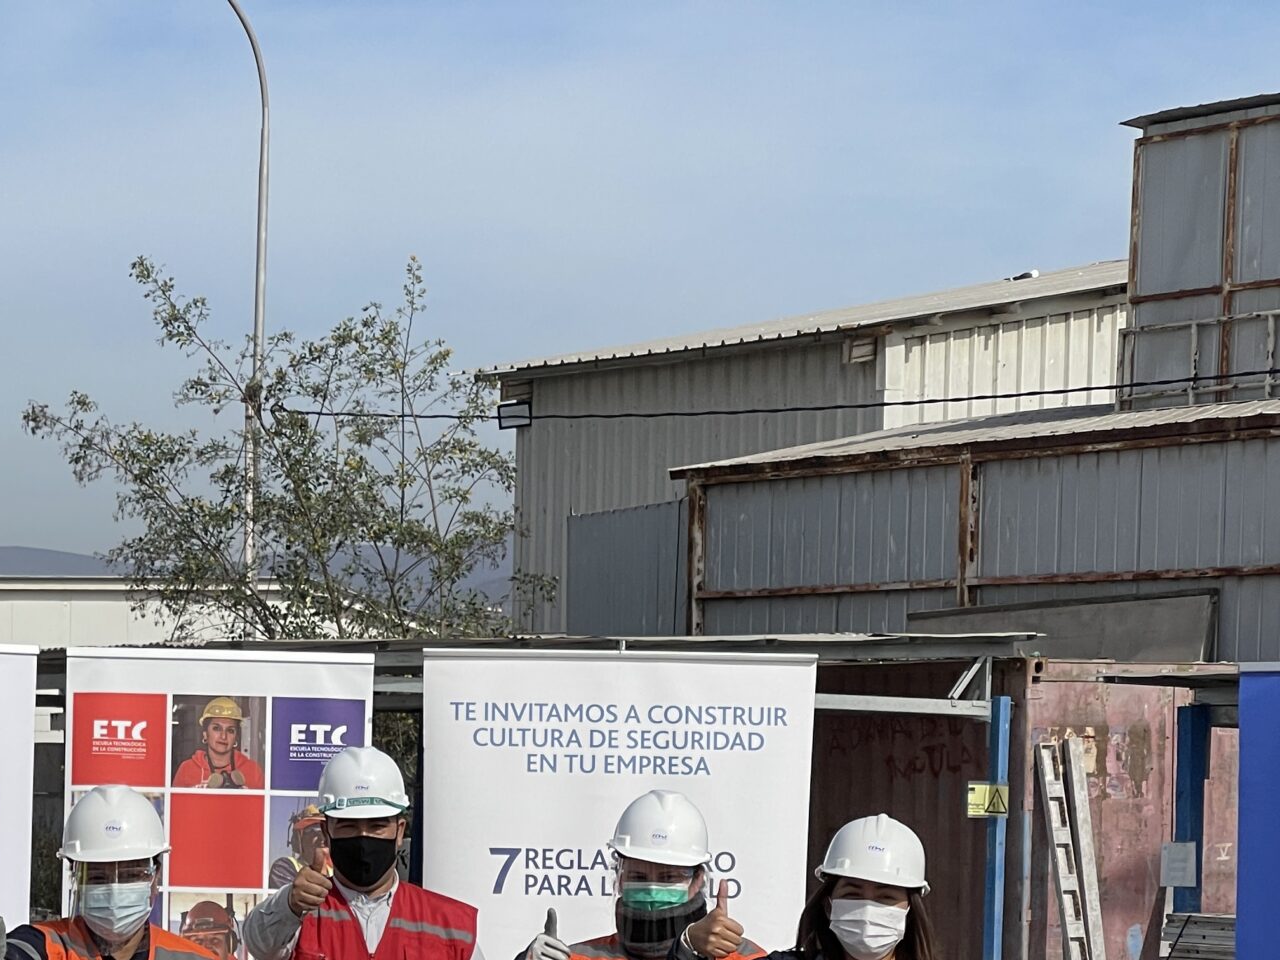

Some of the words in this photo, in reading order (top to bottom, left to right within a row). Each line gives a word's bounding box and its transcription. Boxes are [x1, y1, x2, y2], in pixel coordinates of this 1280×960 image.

[450, 702, 477, 721] TE
[484, 703, 618, 723] INVITAMOS
[624, 705, 641, 724] A
[647, 706, 788, 727] CONSTRUIR
[93, 719, 147, 740] ETC
[290, 724, 347, 746] ETC
[473, 728, 582, 748] CULTURA
[589, 730, 619, 749] DE
[626, 731, 765, 751] SEGURIDAD
[526, 754, 557, 773] EN
[565, 755, 597, 774] TU
[604, 756, 711, 775] EMPRESA
[488, 847, 522, 895] 7
[524, 875, 593, 897] PARA
